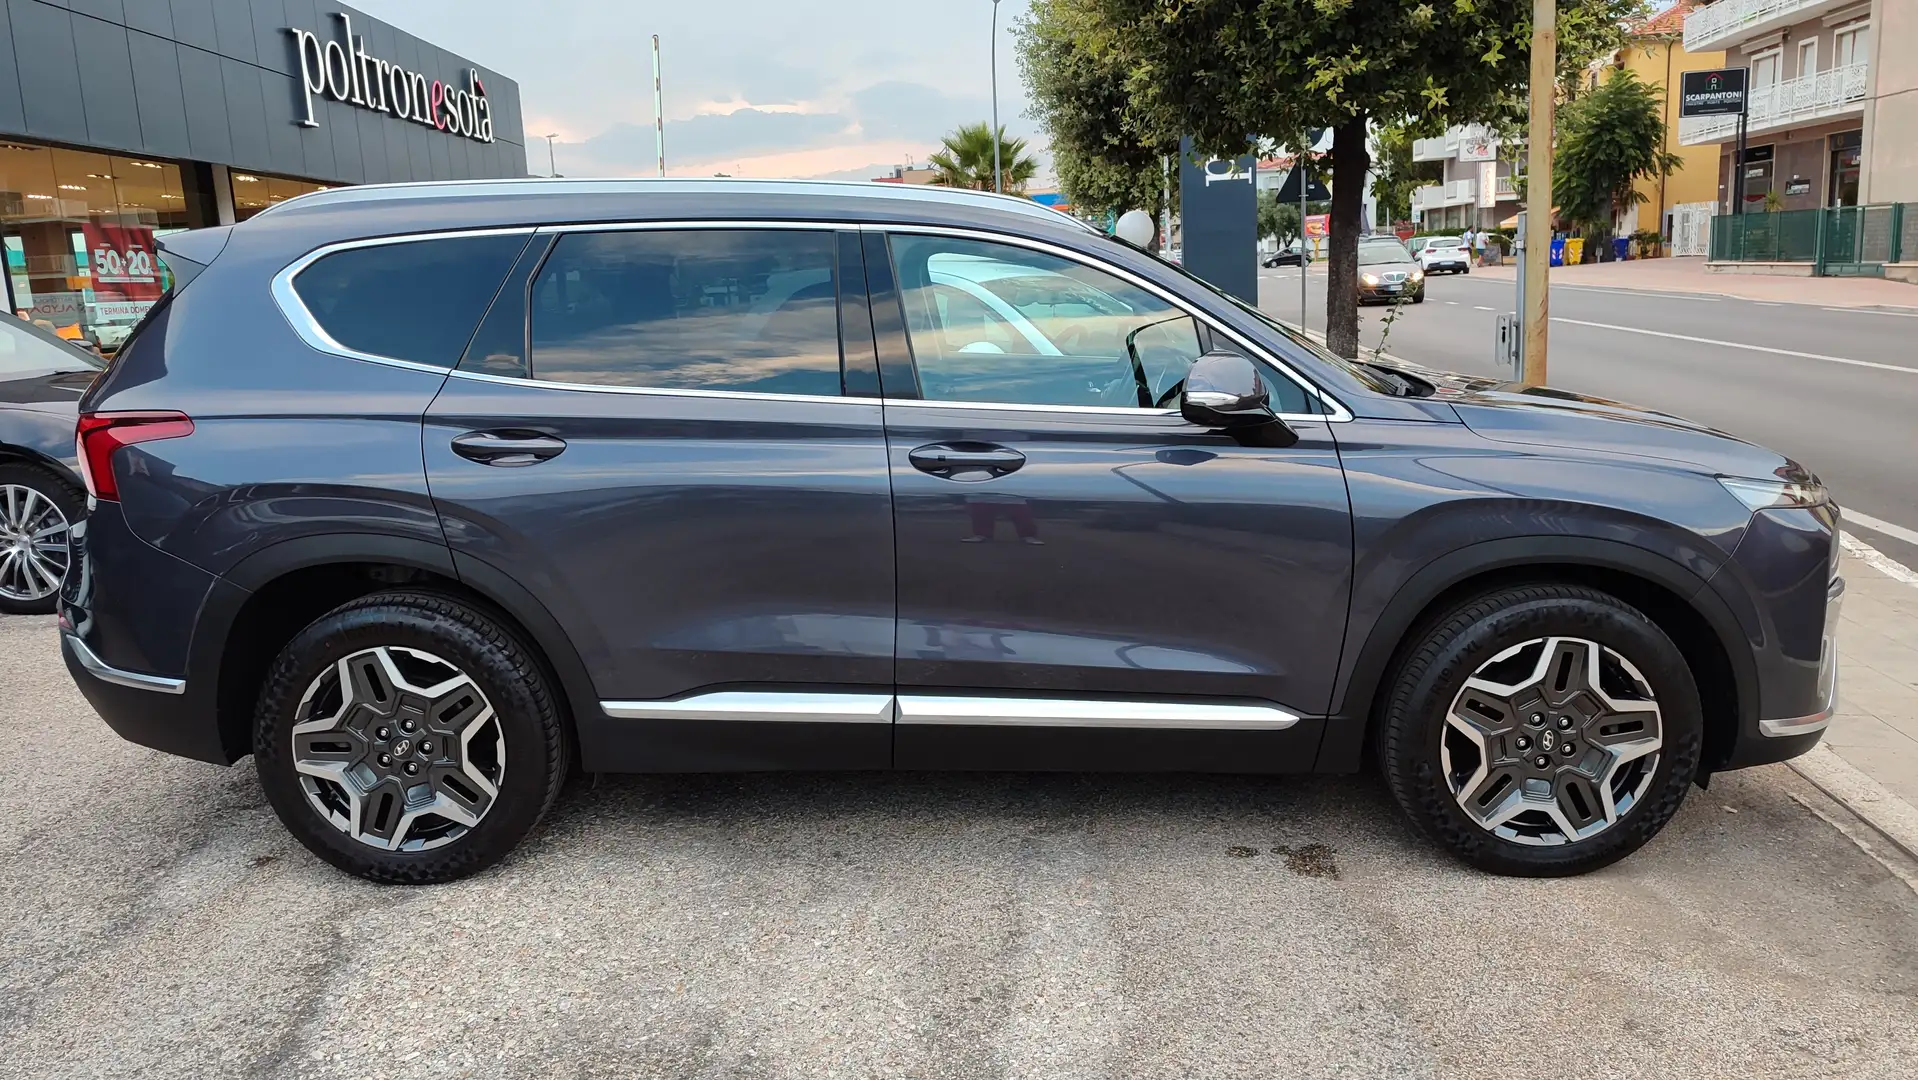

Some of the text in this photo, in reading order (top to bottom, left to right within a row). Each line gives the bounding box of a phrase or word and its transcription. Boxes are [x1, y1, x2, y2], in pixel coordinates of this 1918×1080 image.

[292, 13, 496, 144] poltronesofà
[1685, 91, 1742, 102] SCARPANTONI
[100, 306, 129, 316] TERMINA
